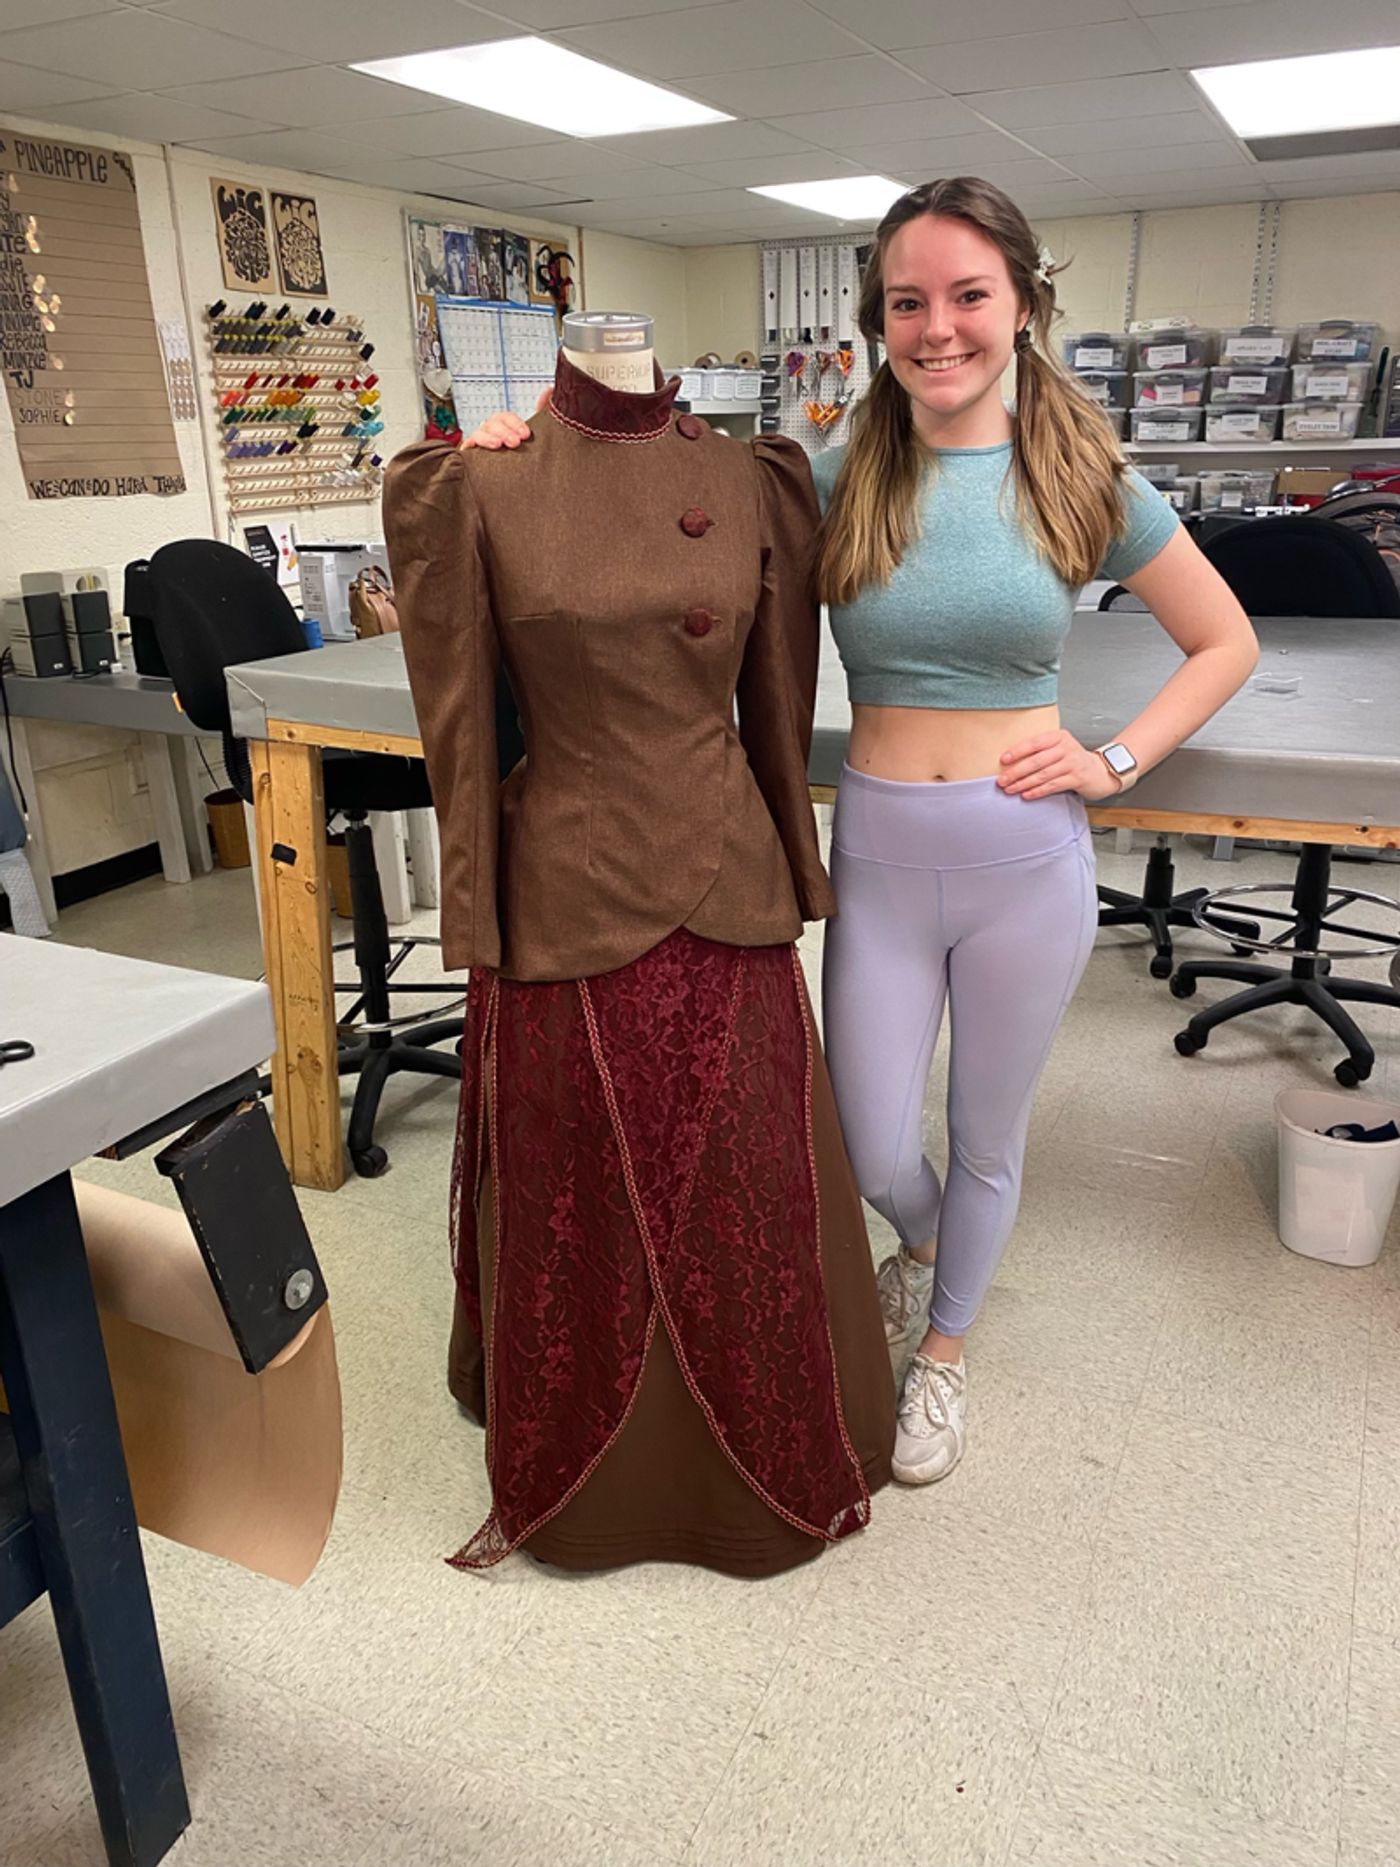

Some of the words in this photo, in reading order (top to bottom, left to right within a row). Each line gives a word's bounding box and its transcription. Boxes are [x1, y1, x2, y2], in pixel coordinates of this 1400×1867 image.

[9, 370, 34, 389] TJ
[19, 408, 61, 423] SOPHIE
[92, 479, 110, 496] DO
